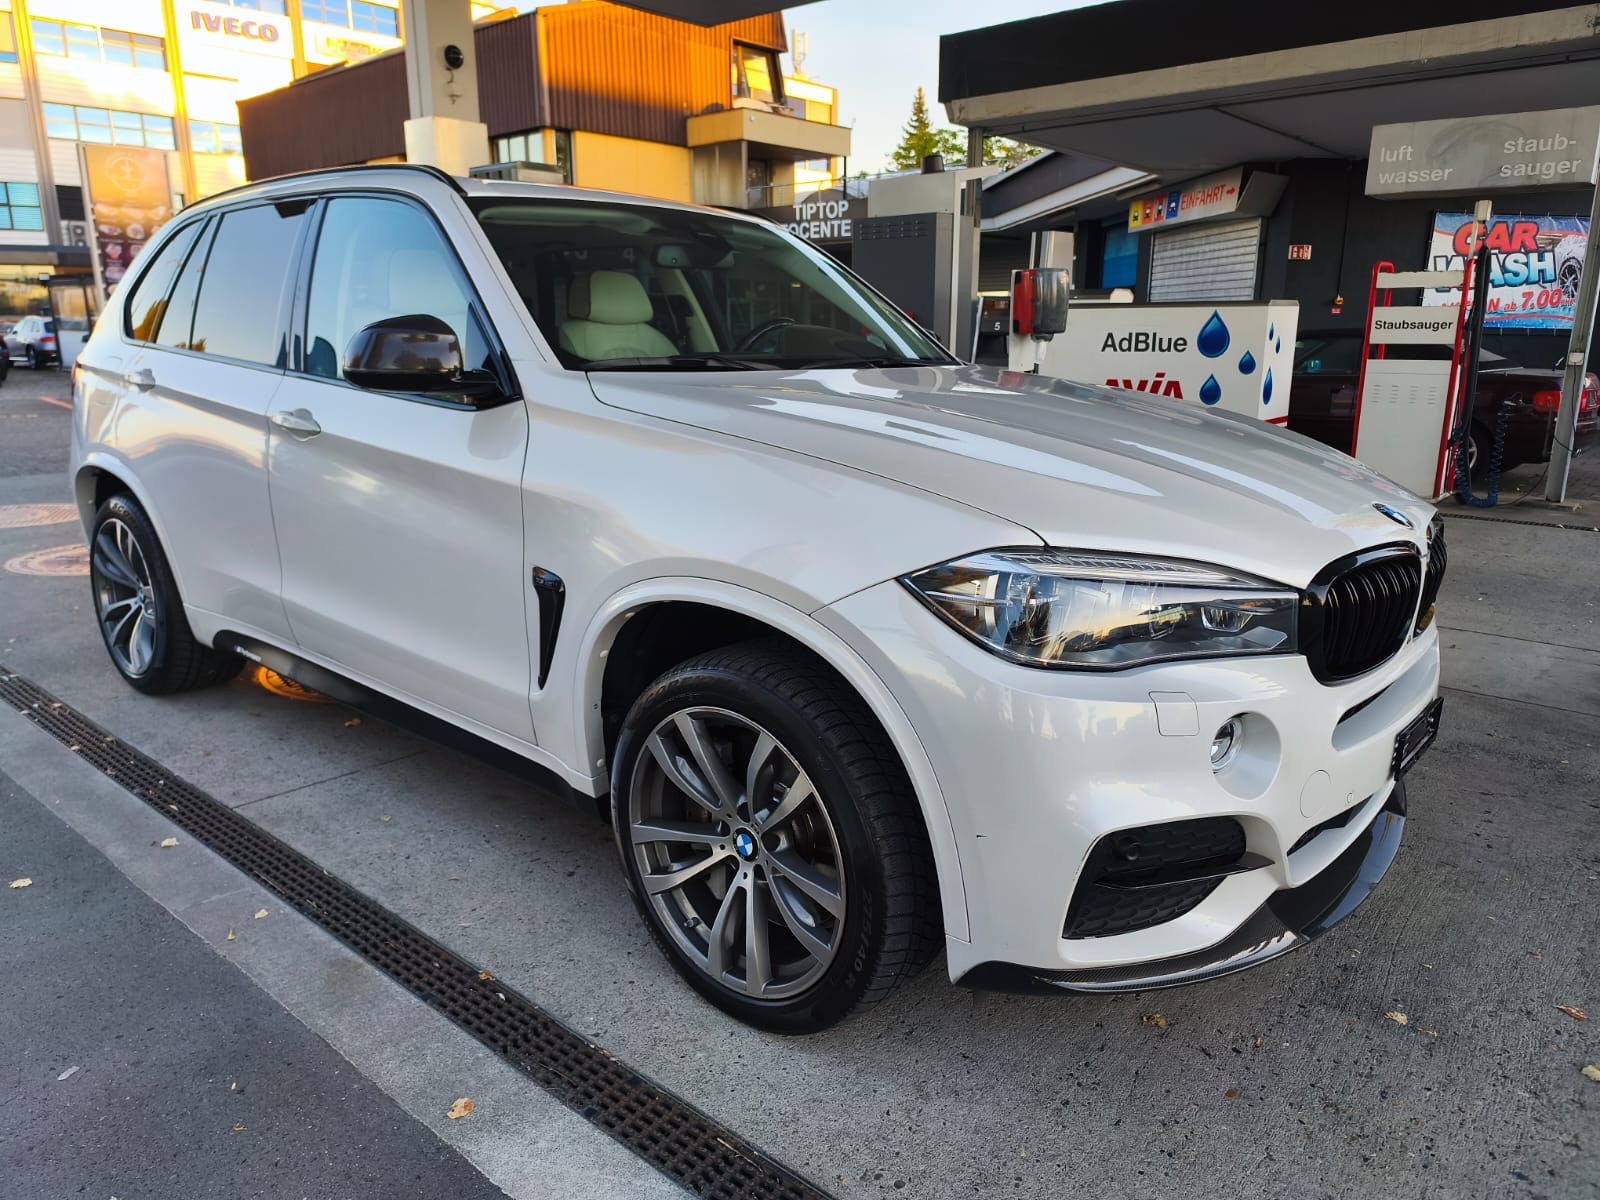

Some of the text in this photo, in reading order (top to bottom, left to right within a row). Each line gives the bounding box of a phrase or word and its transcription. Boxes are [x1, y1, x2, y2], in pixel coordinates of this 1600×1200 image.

[190, 11, 279, 42] IVECO
[1503, 133, 1577, 154] staub-
[1380, 145, 1414, 163] luft
[1378, 167, 1453, 184] wasser
[1500, 158, 1582, 179] sauger
[1180, 184, 1226, 211] EINFAHRT
[793, 201, 849, 220] TIPTOP
[1453, 221, 1539, 254] CAR
[1521, 288, 1563, 310] 7.00
[994, 321, 1001, 331] 5
[1375, 320, 1453, 331] Staubsauger
[1101, 332, 1188, 352] AdBlue
